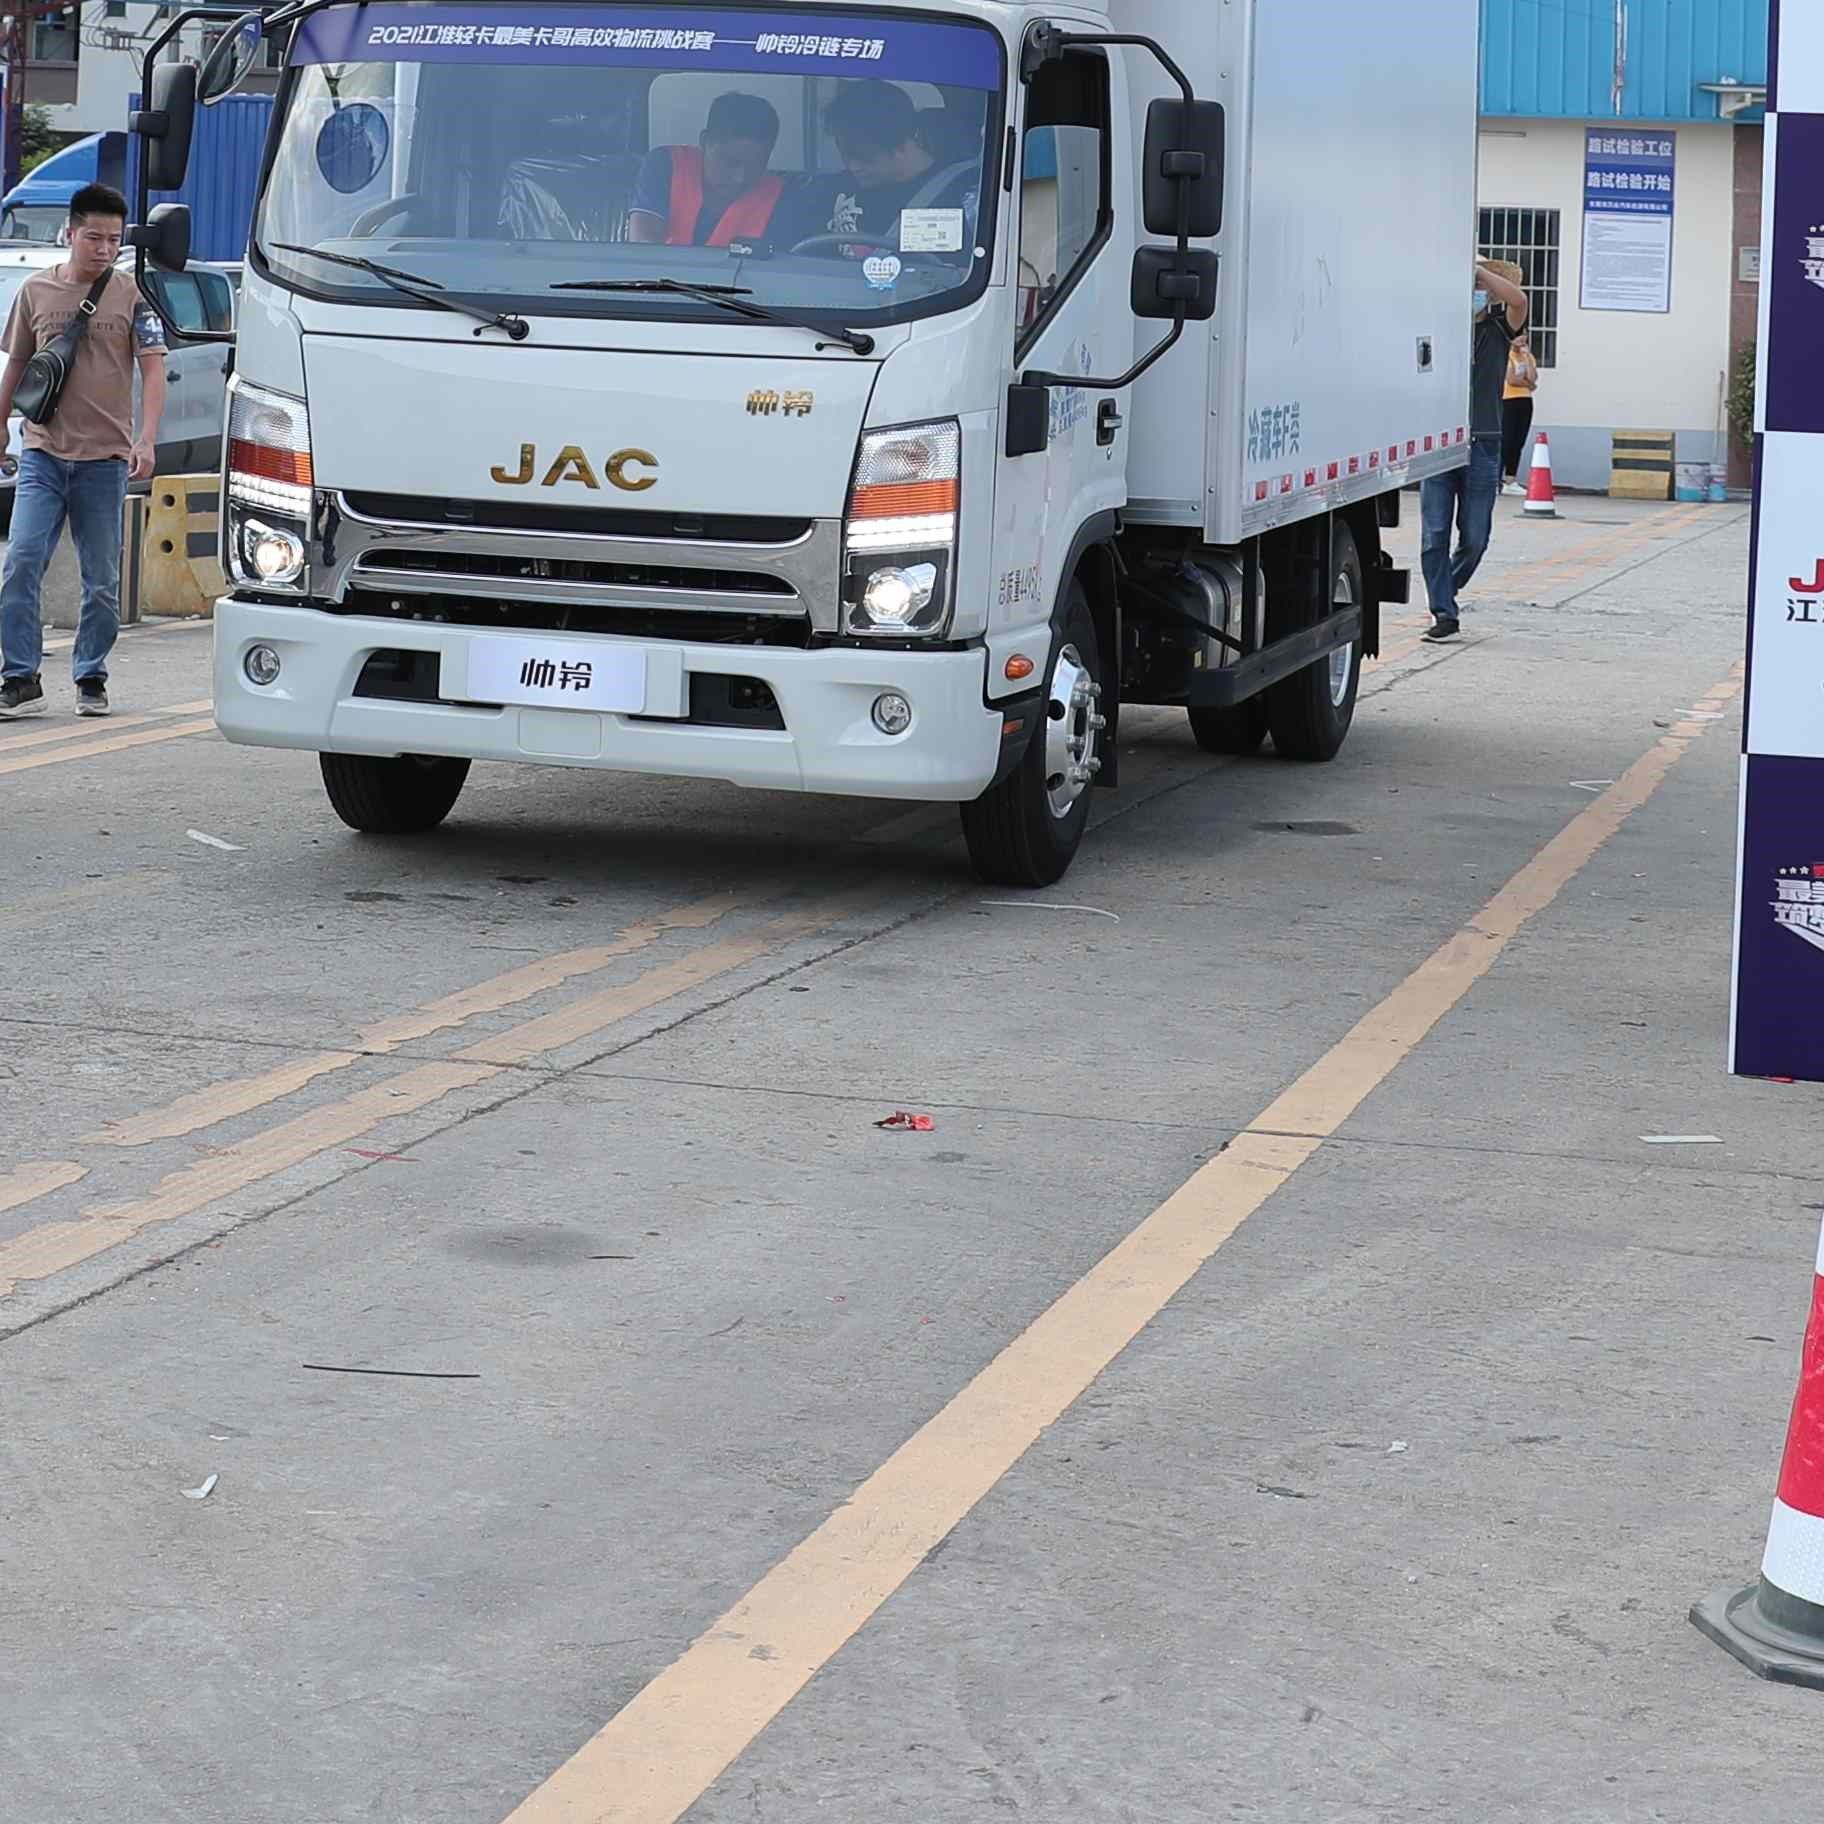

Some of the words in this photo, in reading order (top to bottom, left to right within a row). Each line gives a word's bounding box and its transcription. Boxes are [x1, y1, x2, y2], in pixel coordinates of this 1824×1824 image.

[1587, 171, 1671, 192] 路试检验开始
[746, 388, 814, 417] 帅铃
[490, 443, 659, 491] JAC
[520, 658, 592, 691] 帅铃
